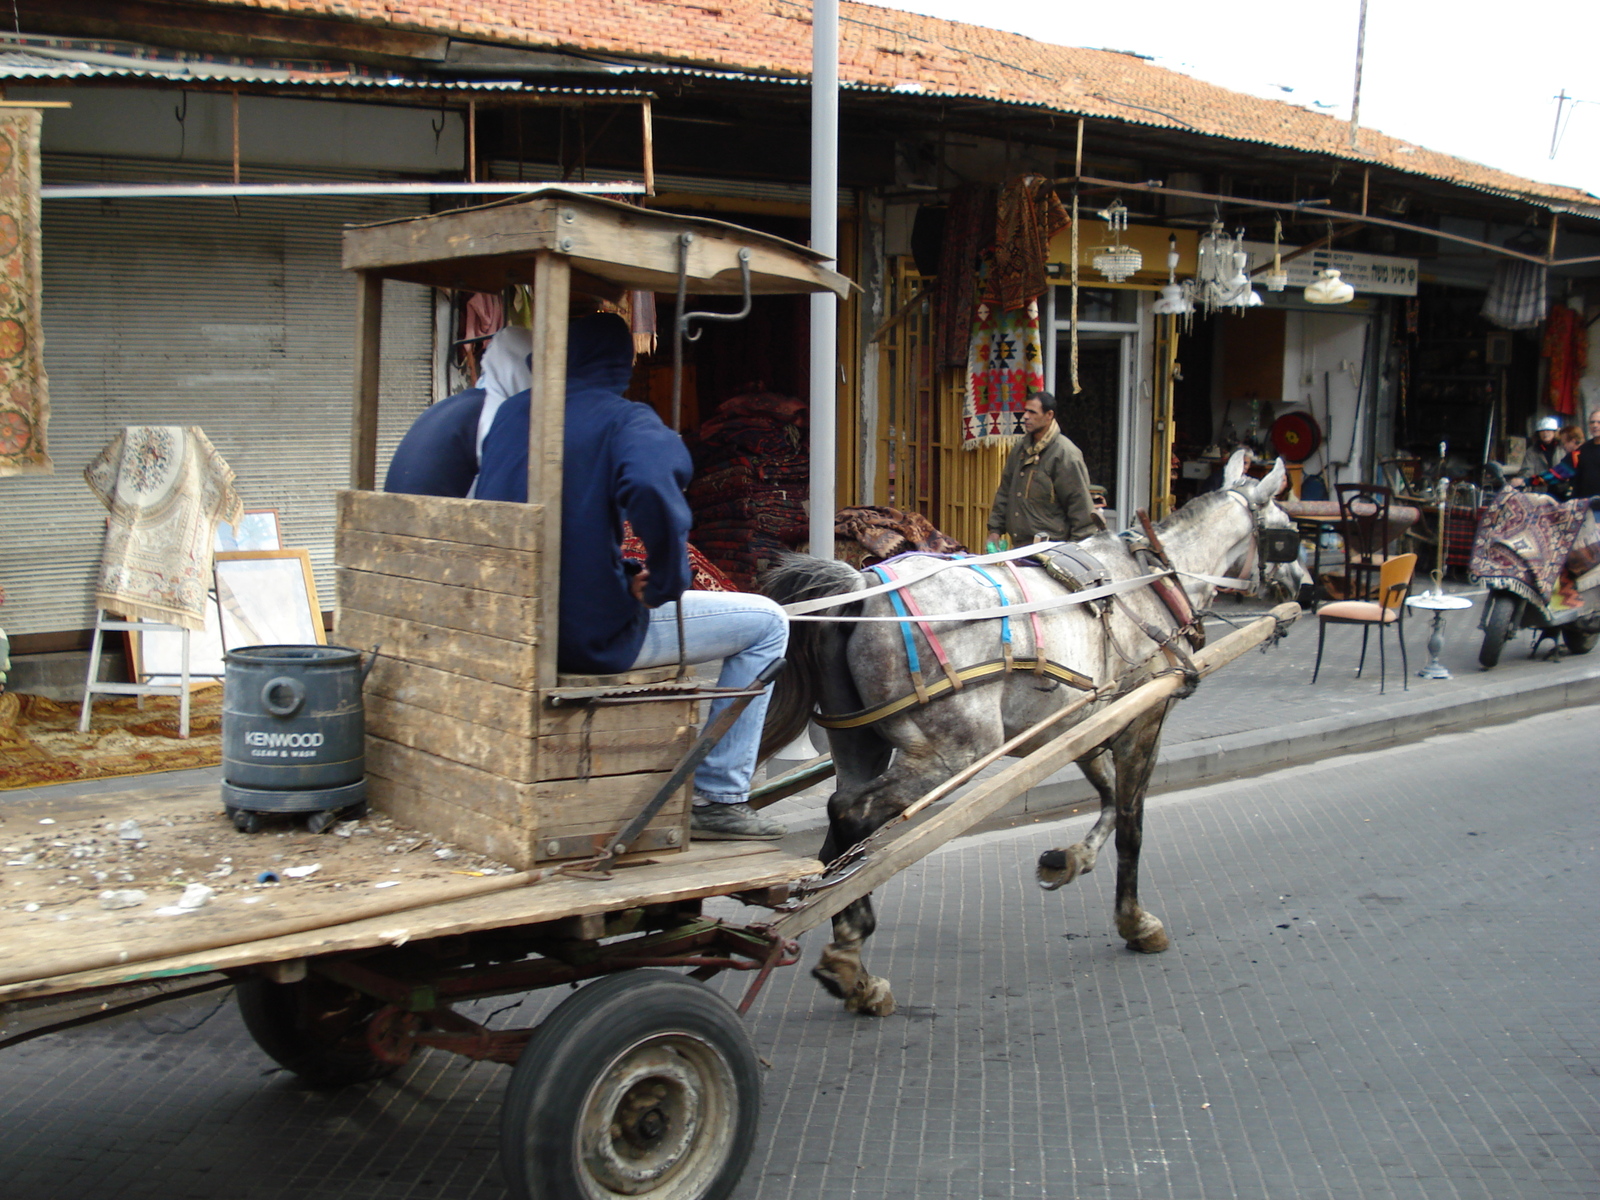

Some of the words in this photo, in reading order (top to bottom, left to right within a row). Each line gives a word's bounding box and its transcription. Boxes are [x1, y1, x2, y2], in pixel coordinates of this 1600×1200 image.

[245, 731, 324, 748] KENWOOD
[251, 749, 279, 757] CLEAN
[280, 750, 288, 758] &
[290, 750, 317, 758] WASH
